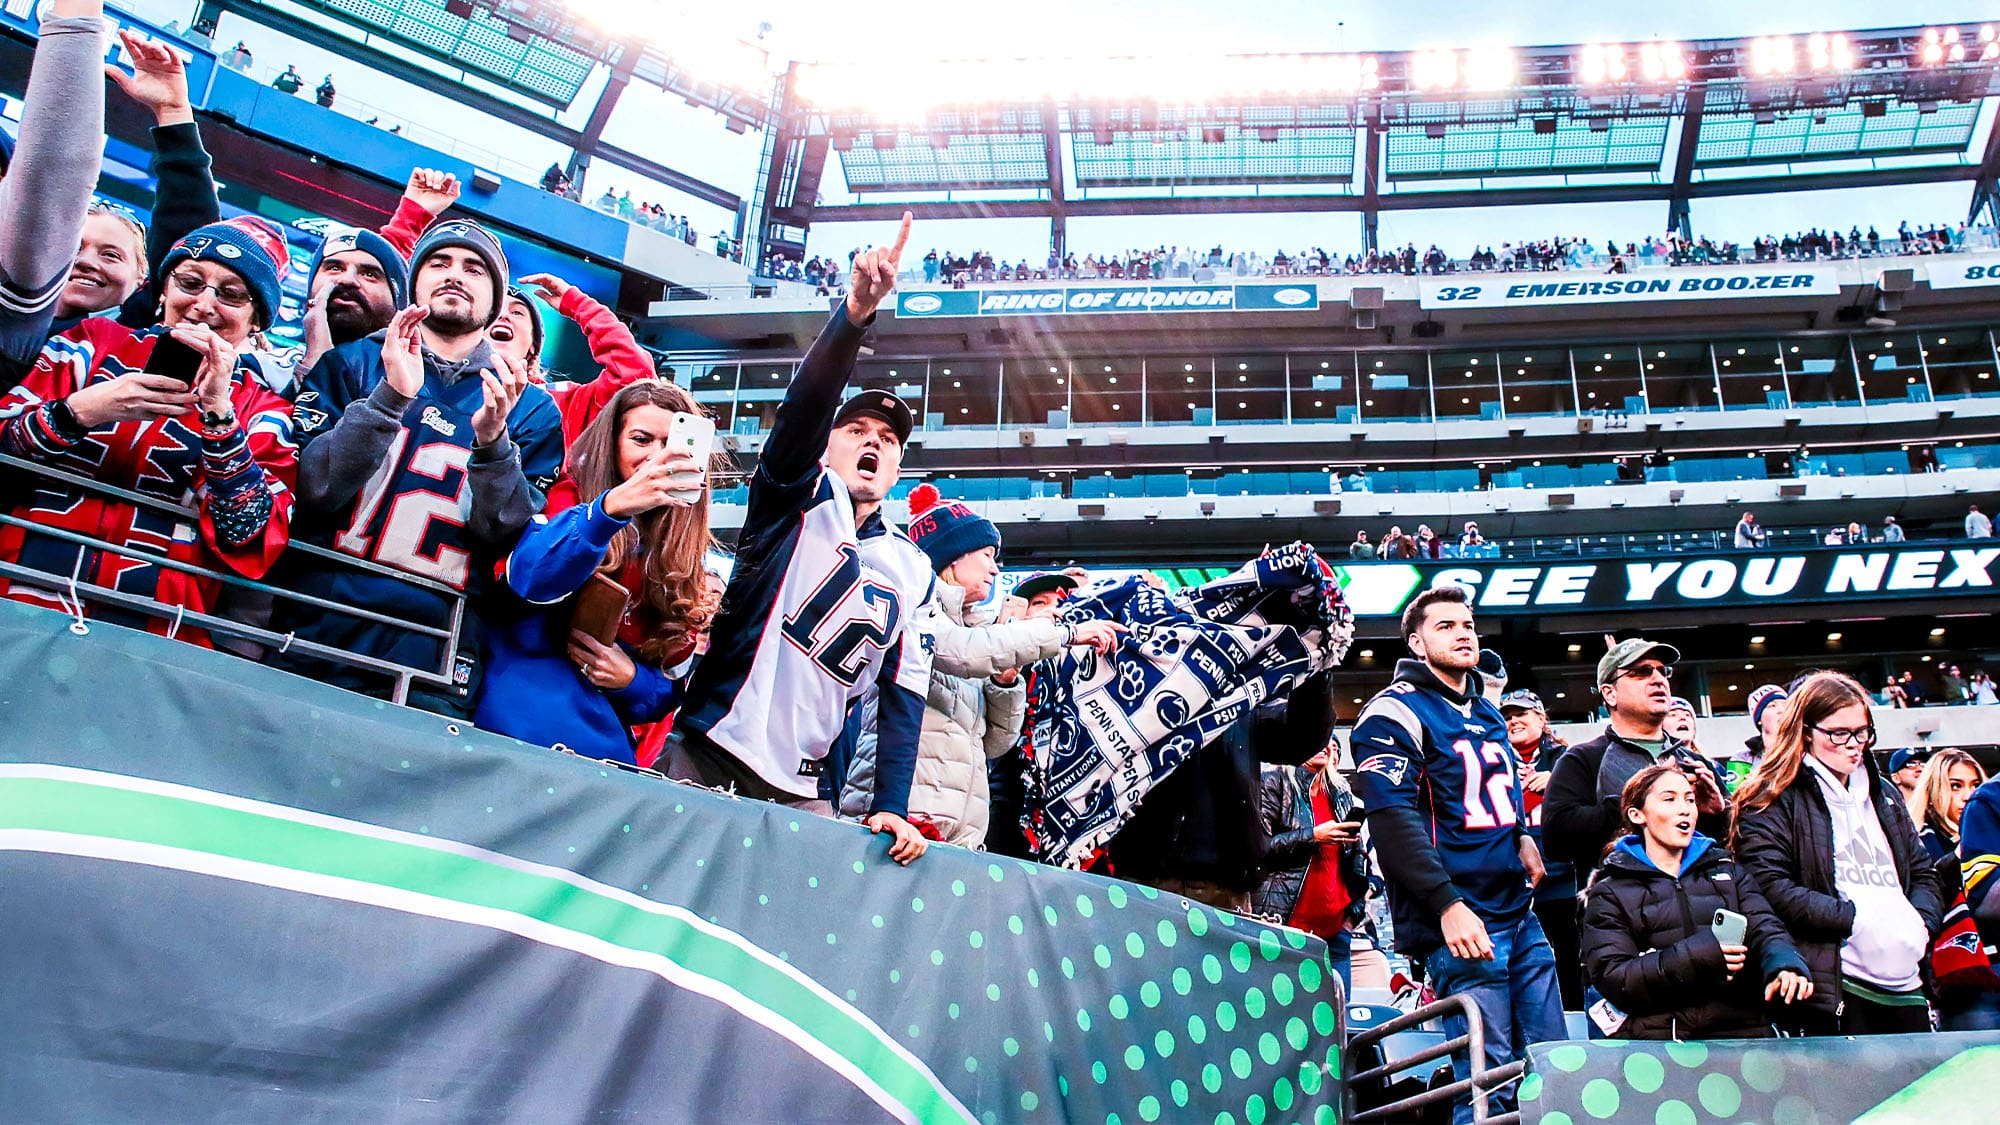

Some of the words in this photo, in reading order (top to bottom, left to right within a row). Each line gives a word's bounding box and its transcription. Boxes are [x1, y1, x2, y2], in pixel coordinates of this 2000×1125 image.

[981, 293, 1063, 310] RING
[1069, 292, 1115, 308] OF
[1115, 290, 1233, 307] HONOR
[1437, 286, 1482, 301] 32
[1506, 279, 1671, 299] EMERSON
[1679, 274, 1814, 292] BOOZER
[334, 427, 472, 590] 12
[1431, 565, 1597, 606] SEE
[1625, 556, 1806, 600] YOU
[1825, 548, 2000, 593] NEX
[781, 542, 900, 687] 12
[1085, 699, 1114, 732] PENN
[1213, 705, 1238, 725] PSU
[1075, 753, 1097, 776] LIONS
[1451, 737, 1517, 830] 12
